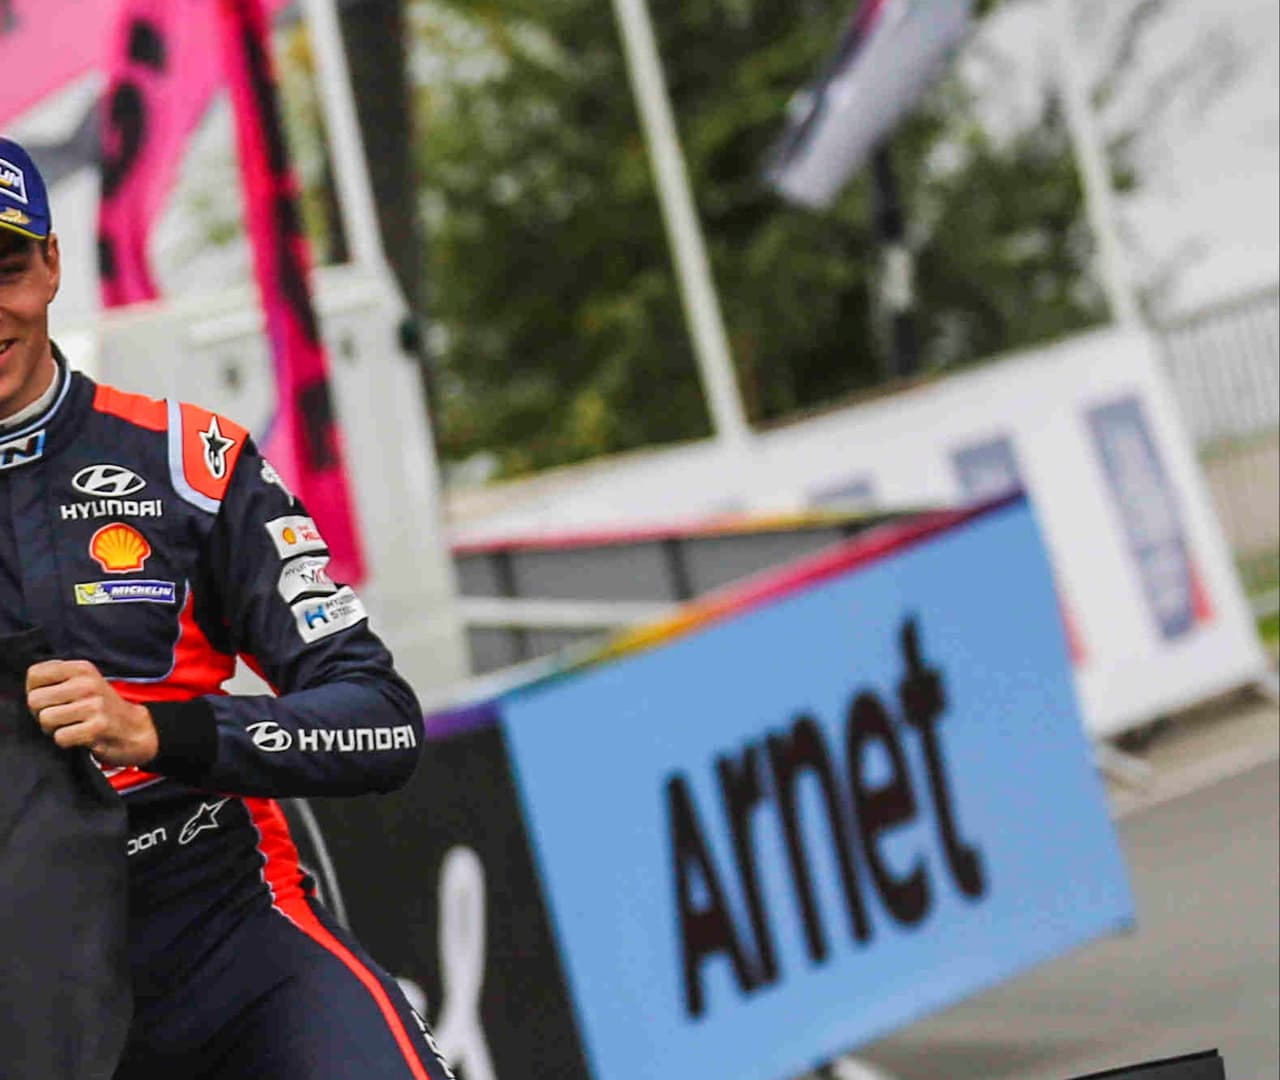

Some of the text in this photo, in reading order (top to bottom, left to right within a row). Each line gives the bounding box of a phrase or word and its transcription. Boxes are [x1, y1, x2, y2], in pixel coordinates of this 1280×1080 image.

[60, 499, 163, 520] HYUNDAI
[110, 583, 173, 597] MICHELIN
[298, 724, 417, 752] HYUNDAI
[664, 612, 991, 1023] Arnet
